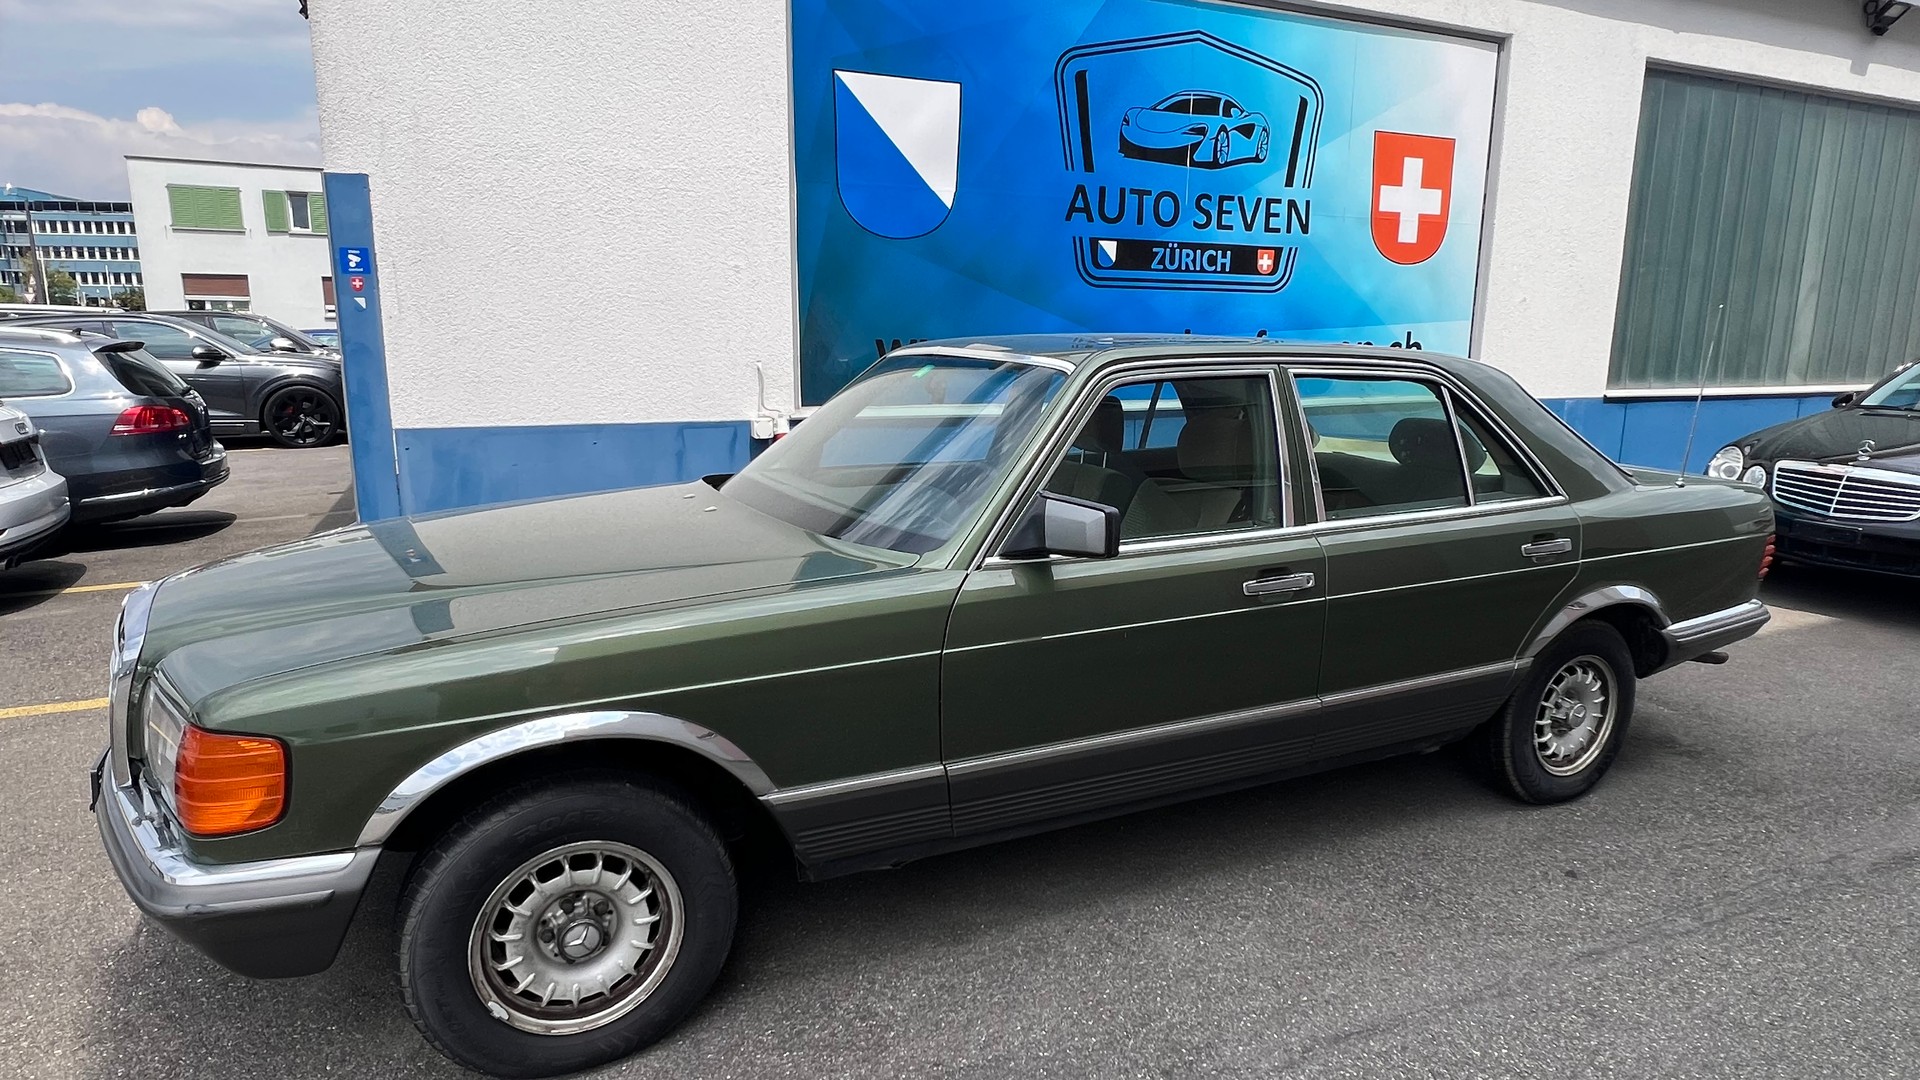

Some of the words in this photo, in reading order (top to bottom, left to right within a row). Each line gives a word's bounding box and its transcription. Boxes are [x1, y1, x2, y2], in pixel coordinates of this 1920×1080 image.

[1065, 184, 1180, 228] AUTO
[1193, 193, 1310, 235] SEVEN
[1151, 243, 1231, 272] ZÜRICH
